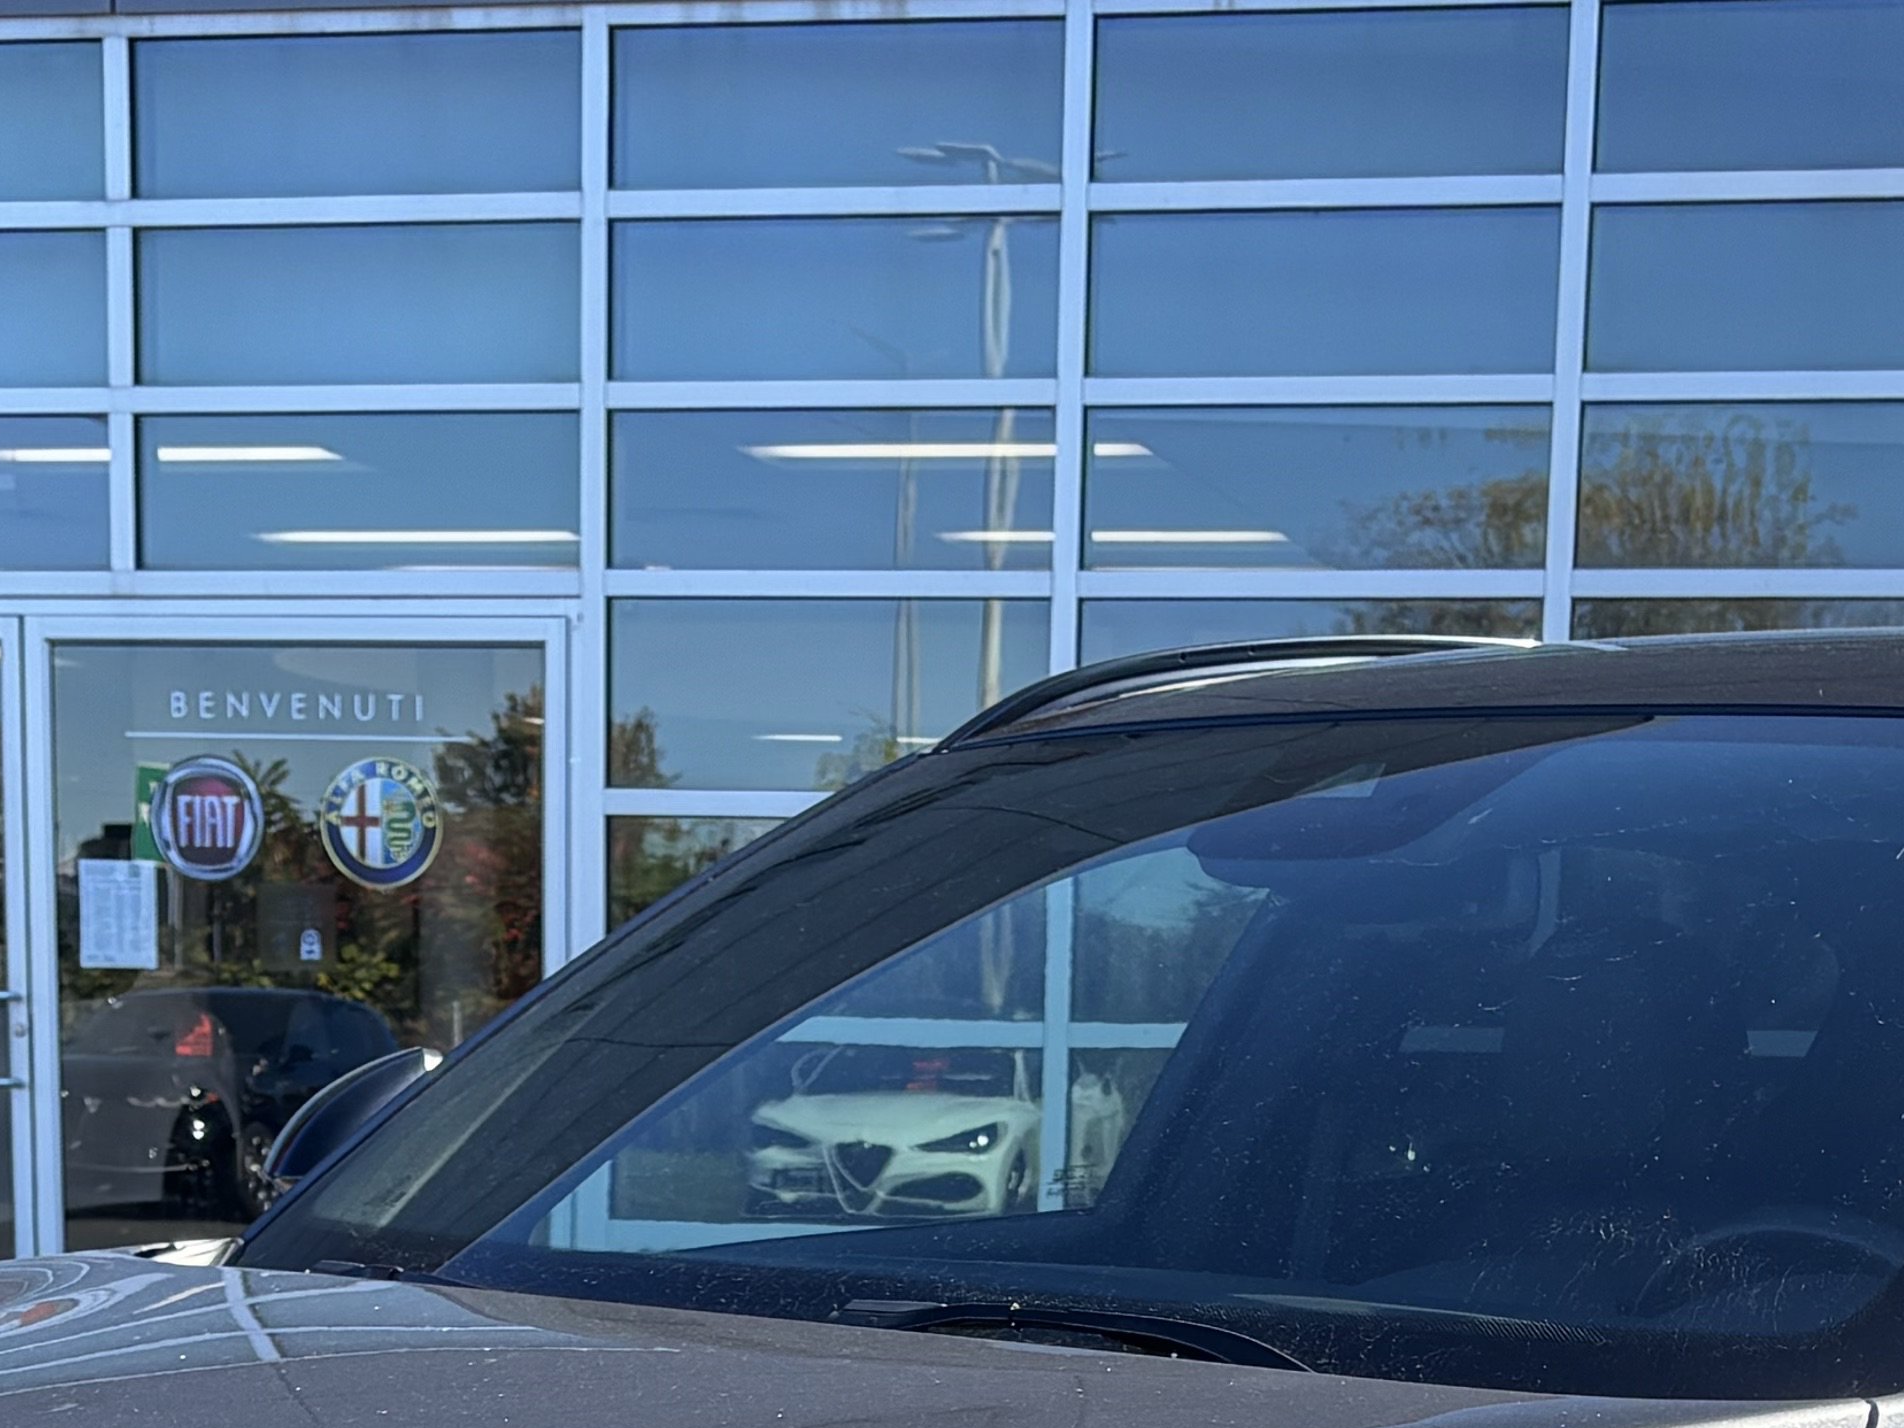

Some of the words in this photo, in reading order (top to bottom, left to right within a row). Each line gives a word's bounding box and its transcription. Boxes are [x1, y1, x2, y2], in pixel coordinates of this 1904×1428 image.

[170, 691, 424, 722] BENVENUTI
[325, 769, 366, 826] ALFA
[375, 761, 437, 829] ROMEO
[177, 796, 242, 849] FIAT
